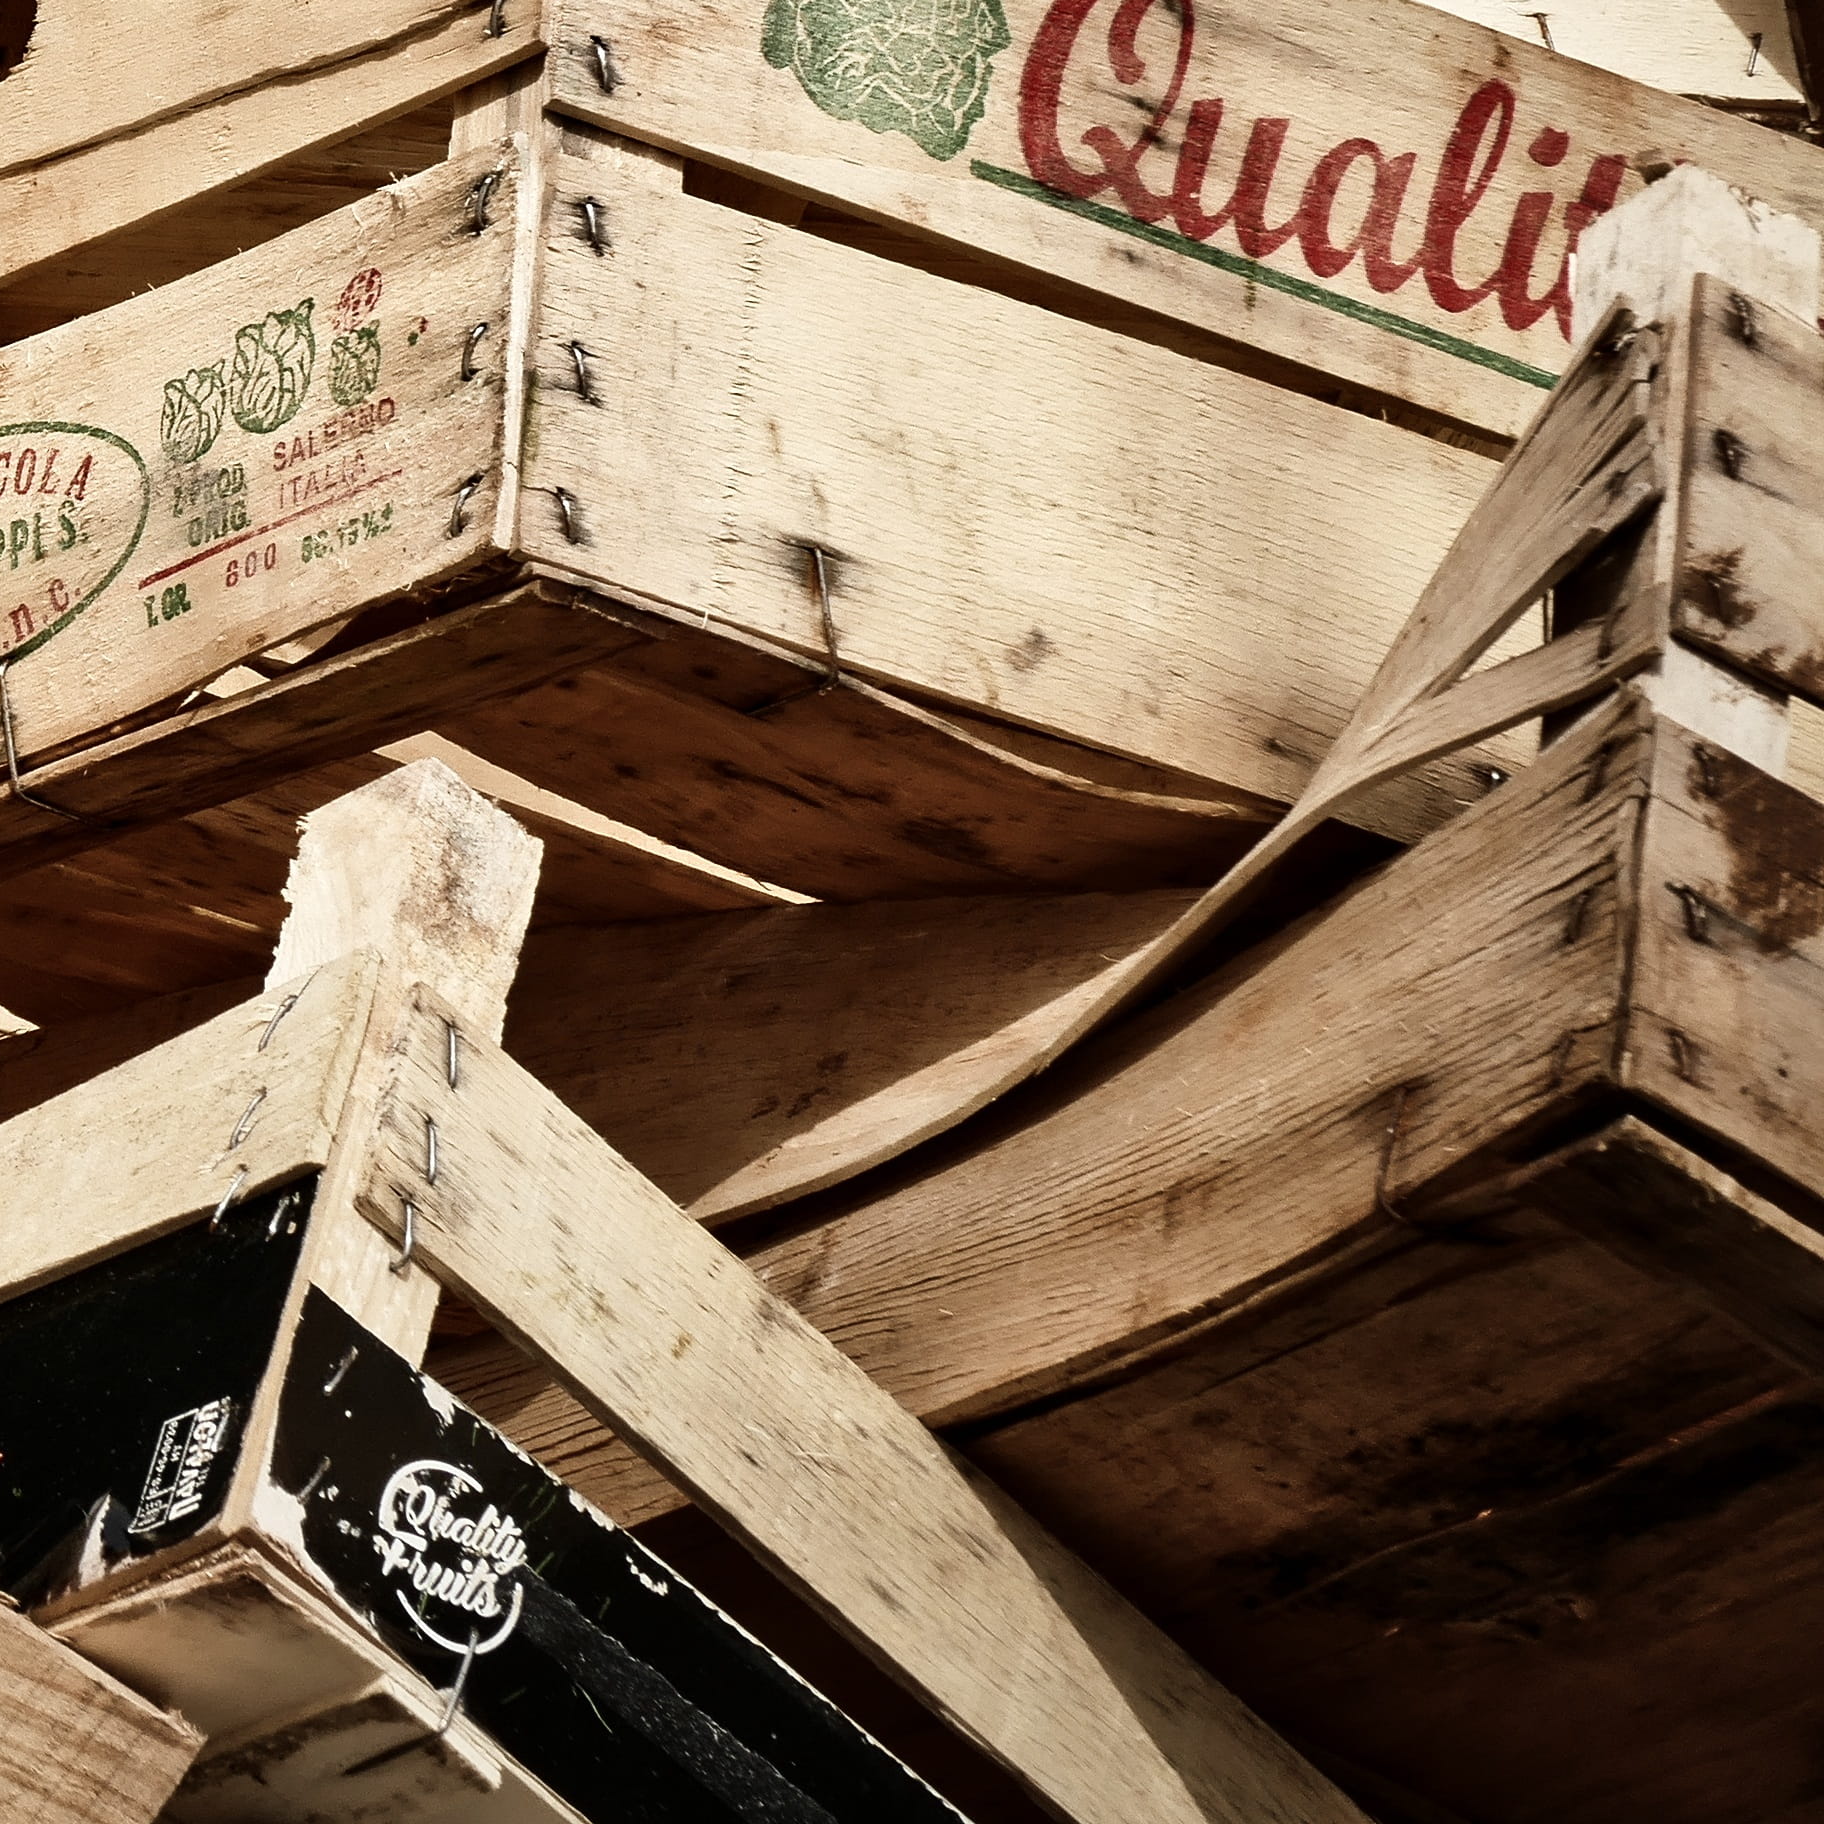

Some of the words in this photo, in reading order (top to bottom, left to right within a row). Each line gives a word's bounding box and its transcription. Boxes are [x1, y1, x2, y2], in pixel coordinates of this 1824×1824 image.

[272, 397, 397, 472] SALERNO
[379, 1485, 527, 1575] Quality
[373, 1535, 500, 1618] Fruits
